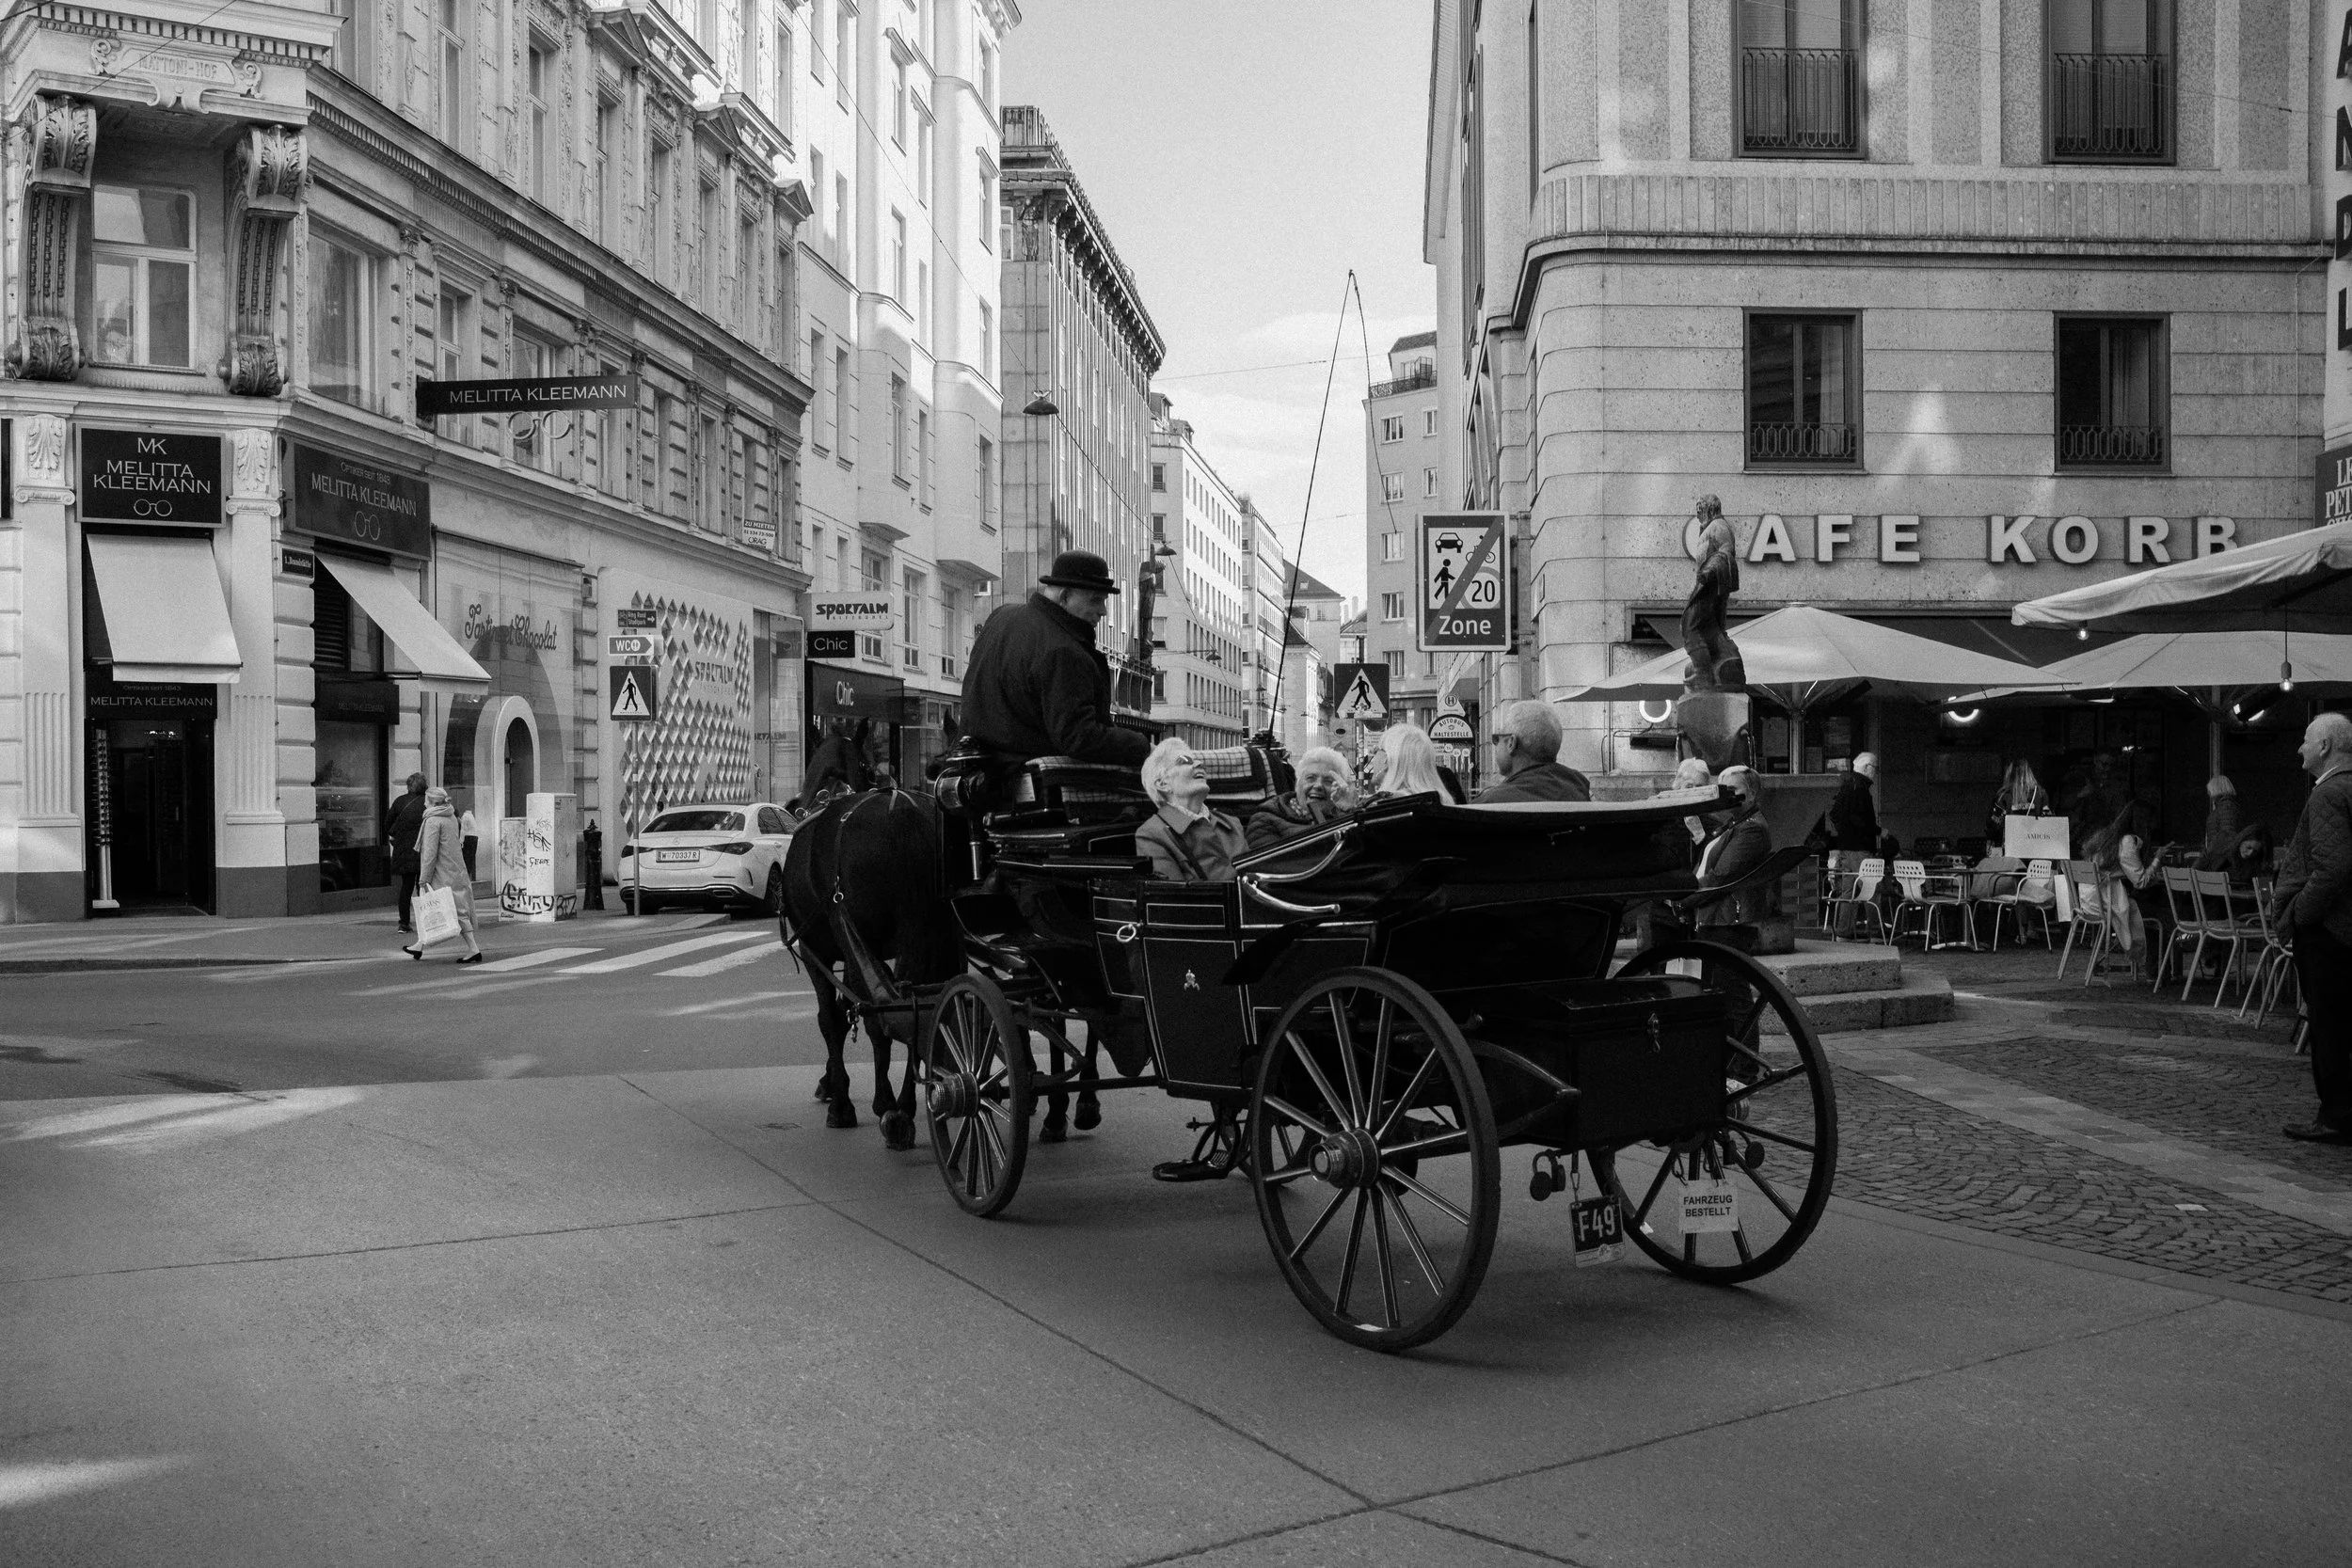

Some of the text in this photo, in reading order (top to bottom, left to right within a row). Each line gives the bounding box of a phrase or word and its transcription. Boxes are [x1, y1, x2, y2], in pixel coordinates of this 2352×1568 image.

[450, 385, 628, 404] MELITTA KLEEMANN
[137, 436, 167, 455] MK
[106, 459, 195, 479] MELITTA
[377, 472, 391, 485] 1843
[93, 474, 211, 494] KLEEMANN
[311, 472, 418, 517] MELITTA KLEEMANN
[1987, 514, 2239, 564] KORB
[1470, 579, 1496, 603] 20
[815, 602, 889, 621] SPORTALM
[515, 613, 558, 651] Chocolat
[1438, 615, 1492, 636] Zone
[615, 640, 631, 652] WC
[814, 637, 849, 652] Chic
[694, 661, 734, 684] SPORTALM
[90, 696, 214, 707] MELITTA KLEEMANN
[836, 680, 854, 706] Chic
[1438, 718, 1465, 728] AUTOBUS
[1683, 1195, 1733, 1205] FAHRZEUG
[1685, 1207, 1731, 1217] BESTELLT
[1578, 1205, 1615, 1242] F49
